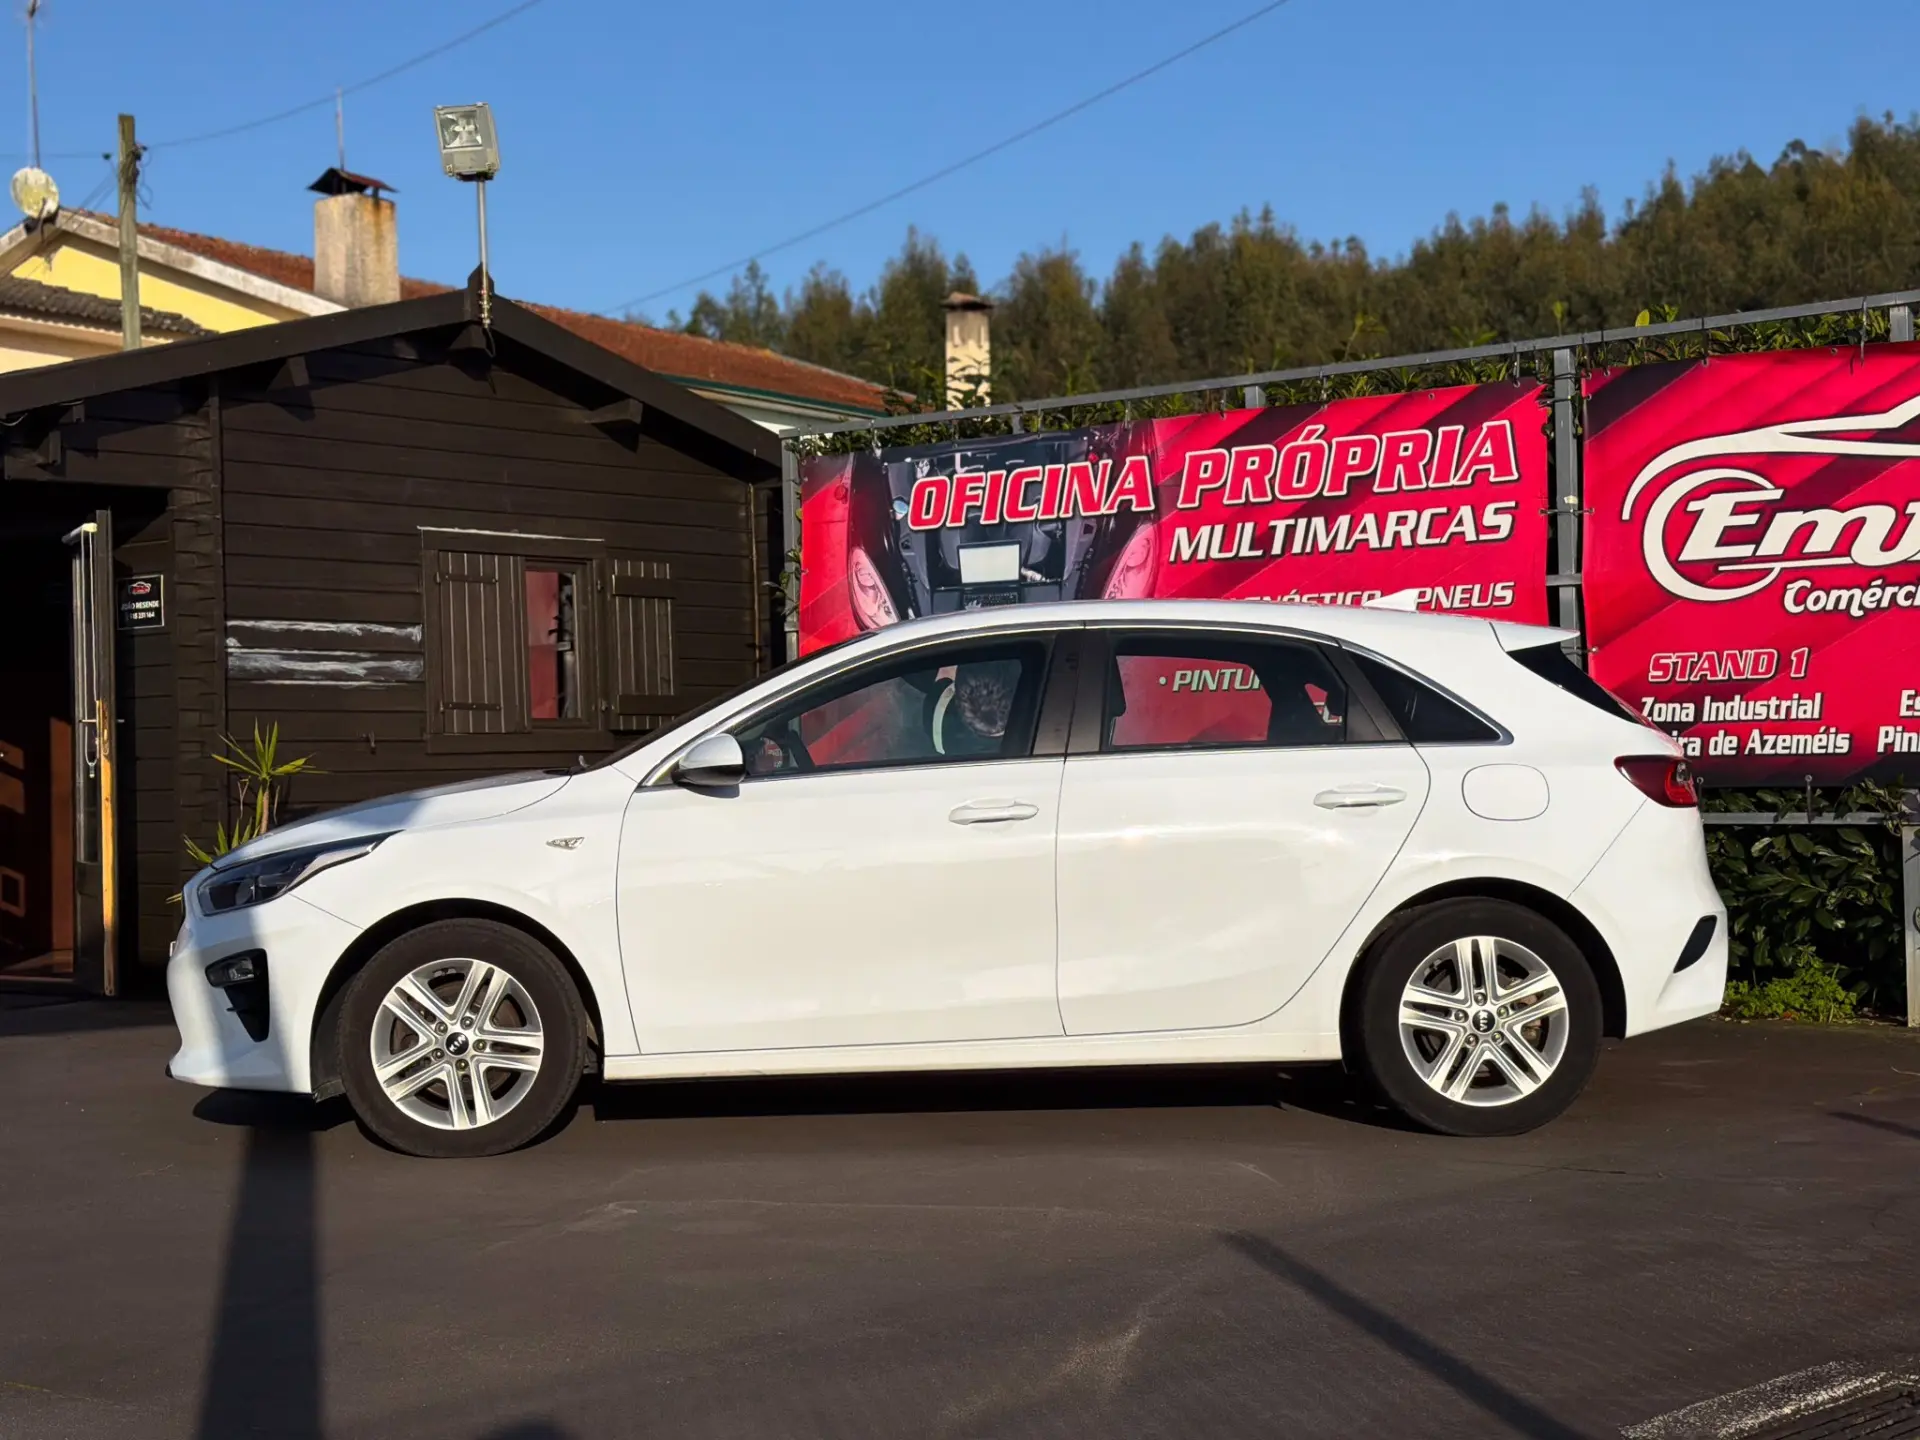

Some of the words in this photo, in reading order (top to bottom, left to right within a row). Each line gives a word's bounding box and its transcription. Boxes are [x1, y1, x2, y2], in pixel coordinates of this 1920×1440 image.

[907, 455, 1155, 532] OFICINA
[1176, 419, 1520, 510] PRÓPRIA
[1168, 500, 1517, 564] MULTIMARCAS
[135, 600, 159, 609] RESENDE
[1414, 581, 1515, 611] PNEUS
[1648, 648, 1778, 682] STAND
[1790, 647, 1809, 679] 1
[1172, 668, 1260, 692] PINTU
[1640, 696, 1696, 722] Zona
[1702, 692, 1823, 722] Industrial
[1708, 729, 1739, 756] de
[1744, 725, 1851, 756] Azeméis
[1877, 725, 1920, 753] Pin
